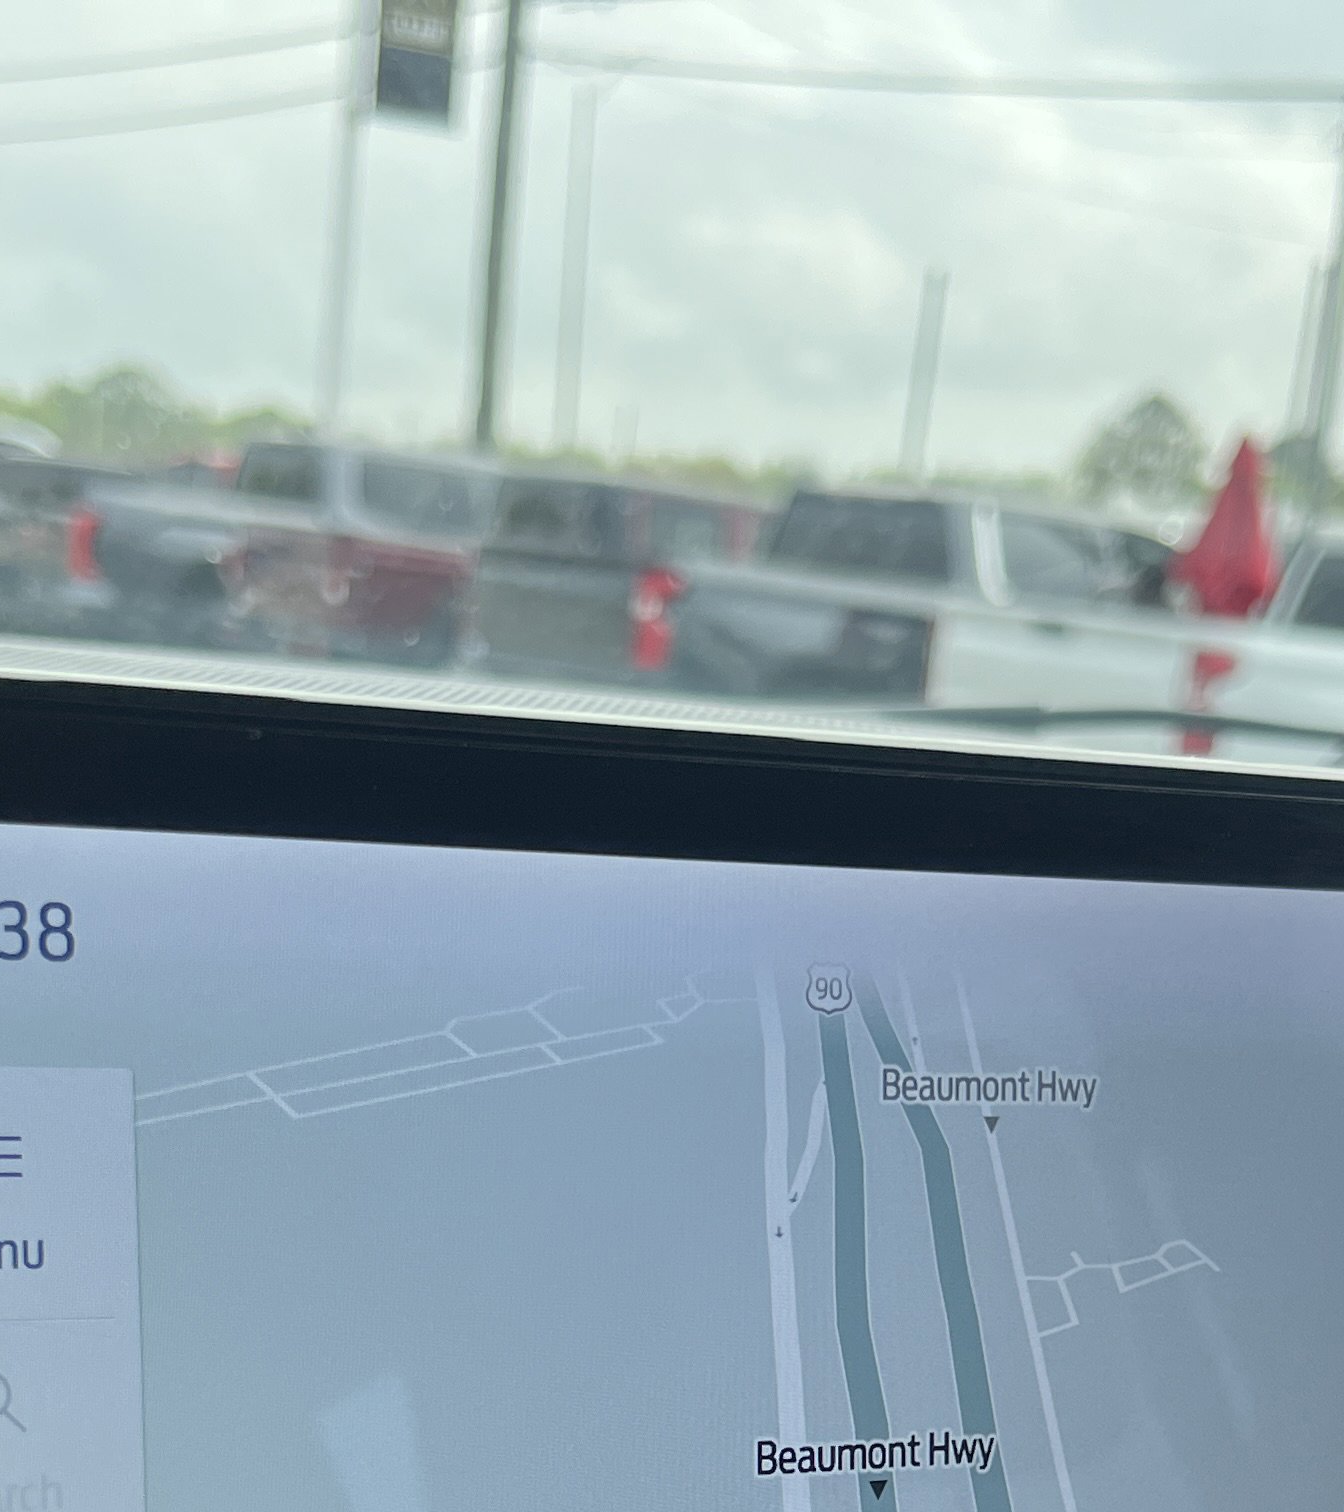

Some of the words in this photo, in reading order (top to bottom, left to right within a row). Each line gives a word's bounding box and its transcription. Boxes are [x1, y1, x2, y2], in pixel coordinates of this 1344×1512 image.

[814, 976, 843, 1002] 90
[881, 1067, 1030, 1103] Beaumont
[1037, 1070, 1097, 1109] Hwy
[756, 1434, 921, 1476] Beaumont
[928, 1432, 995, 1470] Hwy
